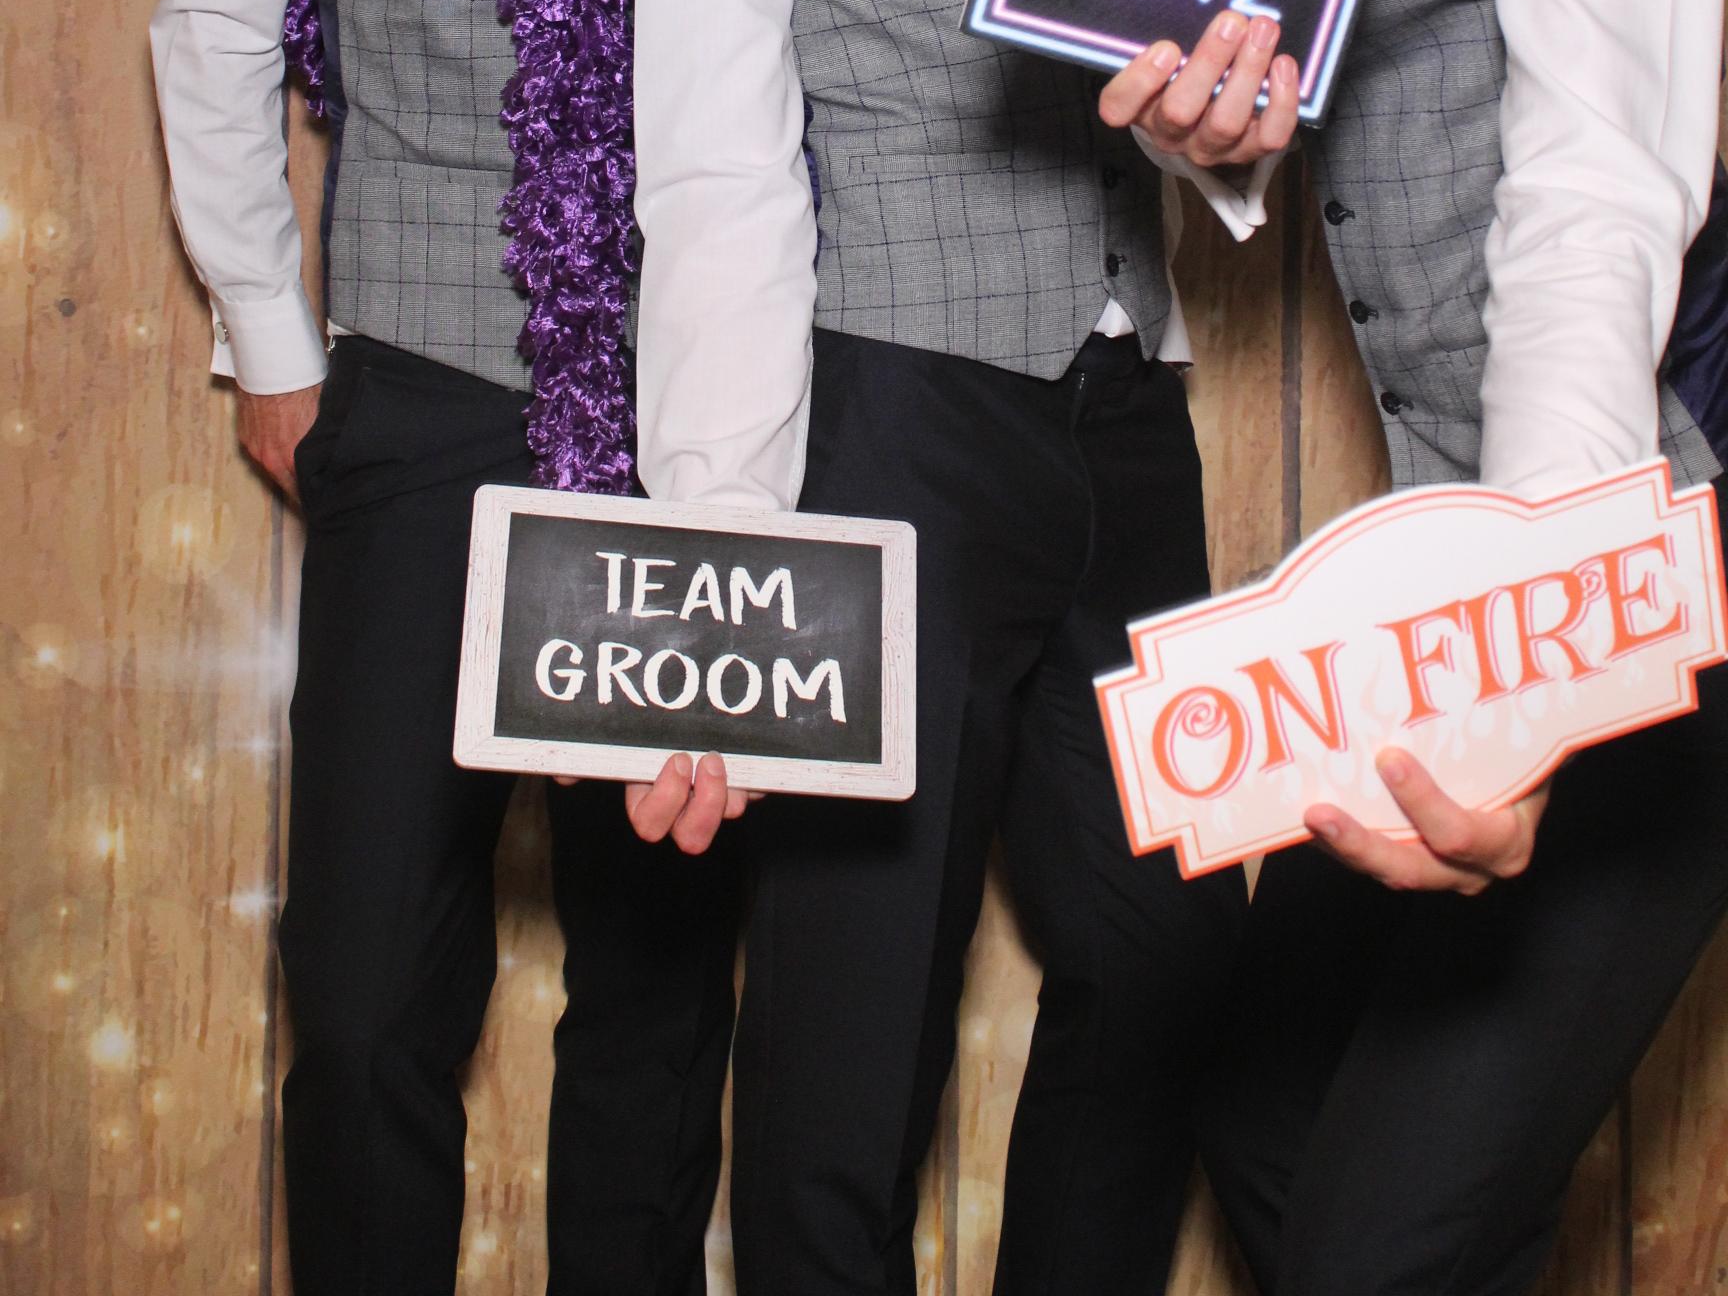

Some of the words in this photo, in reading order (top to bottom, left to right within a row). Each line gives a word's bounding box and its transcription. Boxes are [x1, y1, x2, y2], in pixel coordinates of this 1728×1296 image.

[595, 551, 797, 630] TEAM
[535, 639, 847, 723] GROOM
[1152, 641, 1347, 800] ON
[1375, 534, 1690, 729] FIRE
